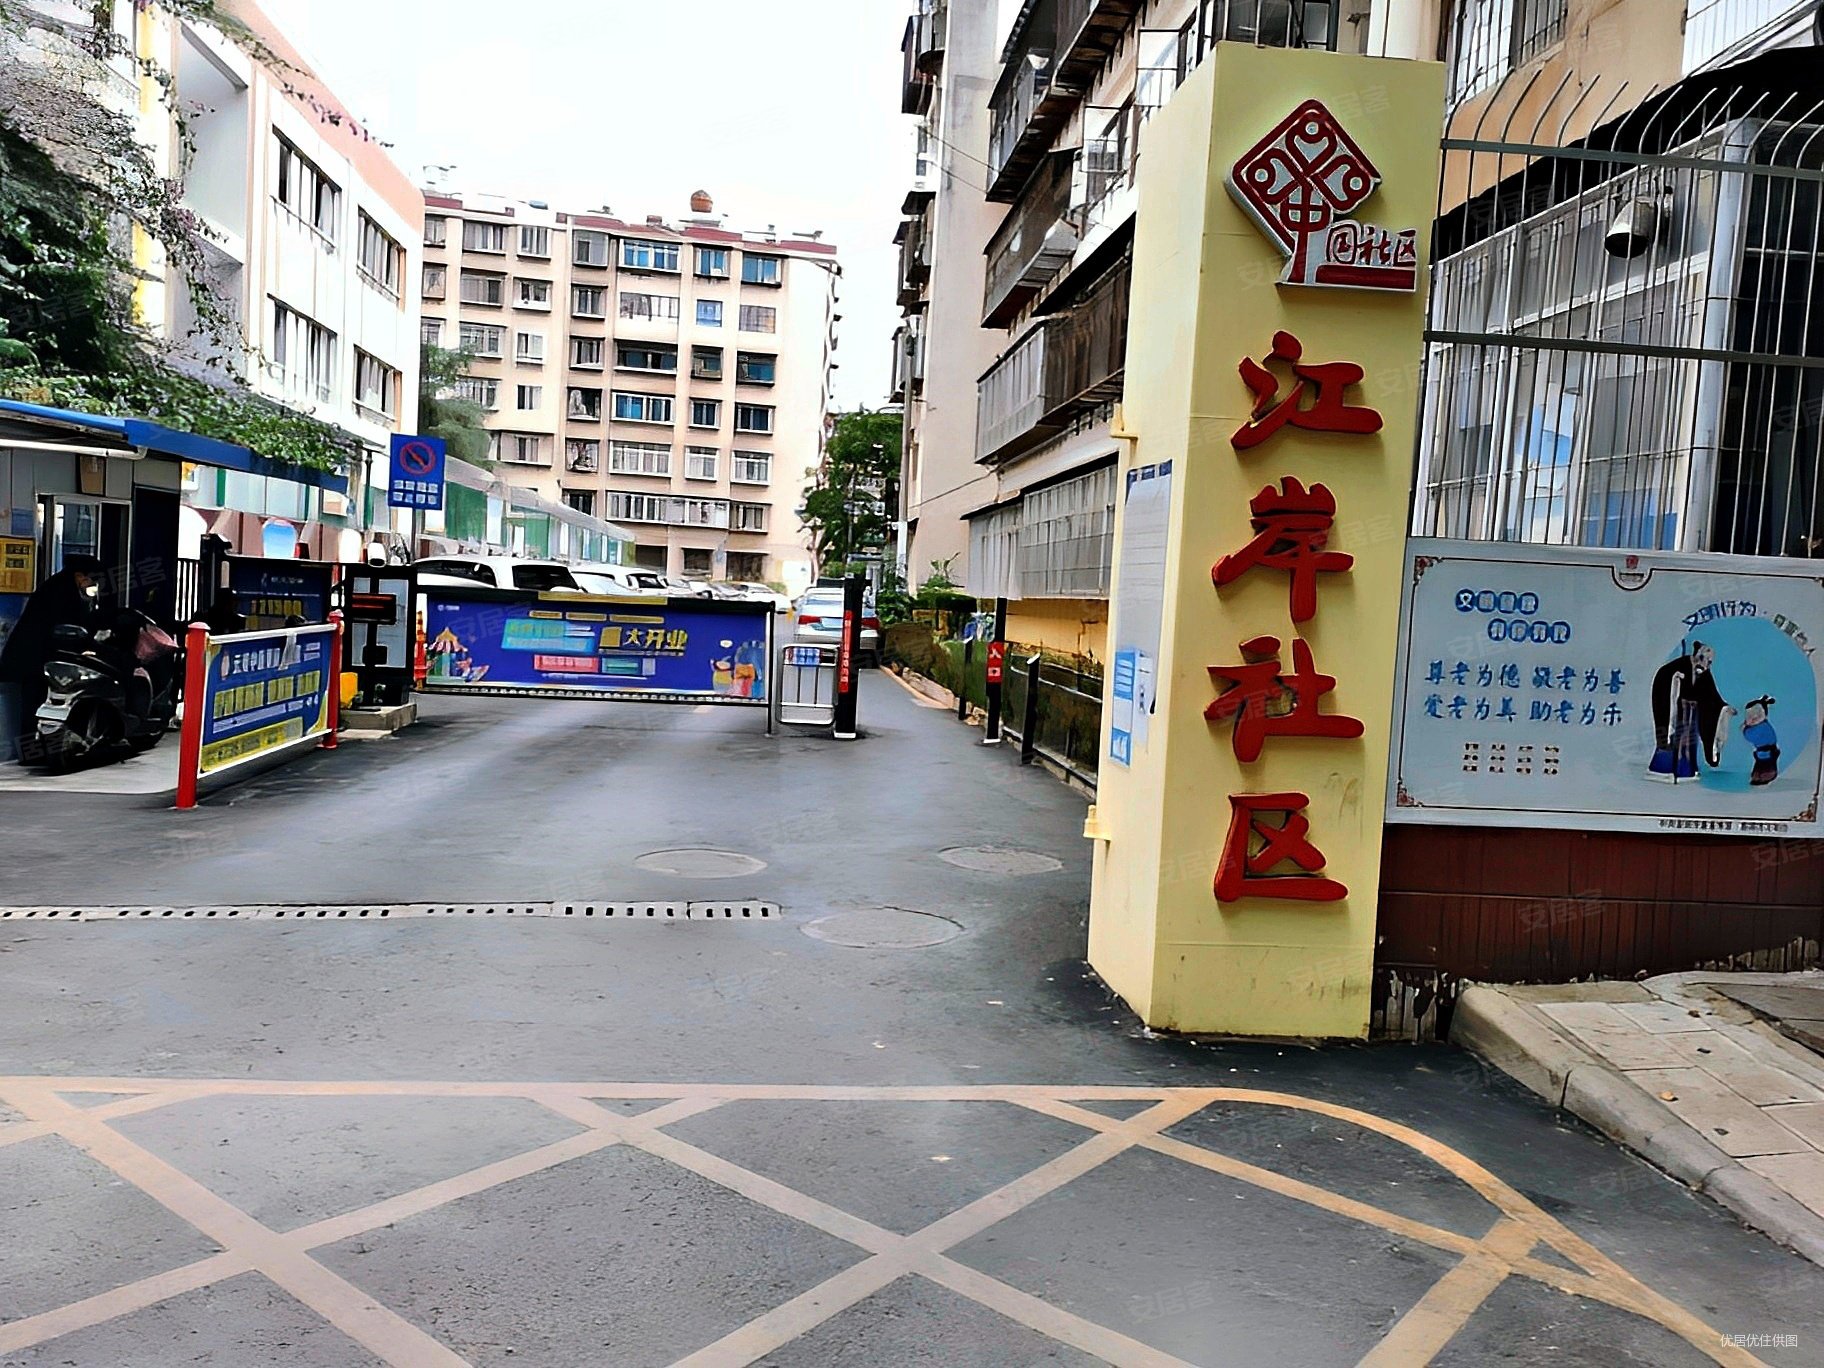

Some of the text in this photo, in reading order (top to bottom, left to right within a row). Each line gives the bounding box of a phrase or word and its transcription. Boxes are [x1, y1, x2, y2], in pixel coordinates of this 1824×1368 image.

[600, 625, 688, 651] 大开业
[1205, 332, 1381, 904] 江岸社区
